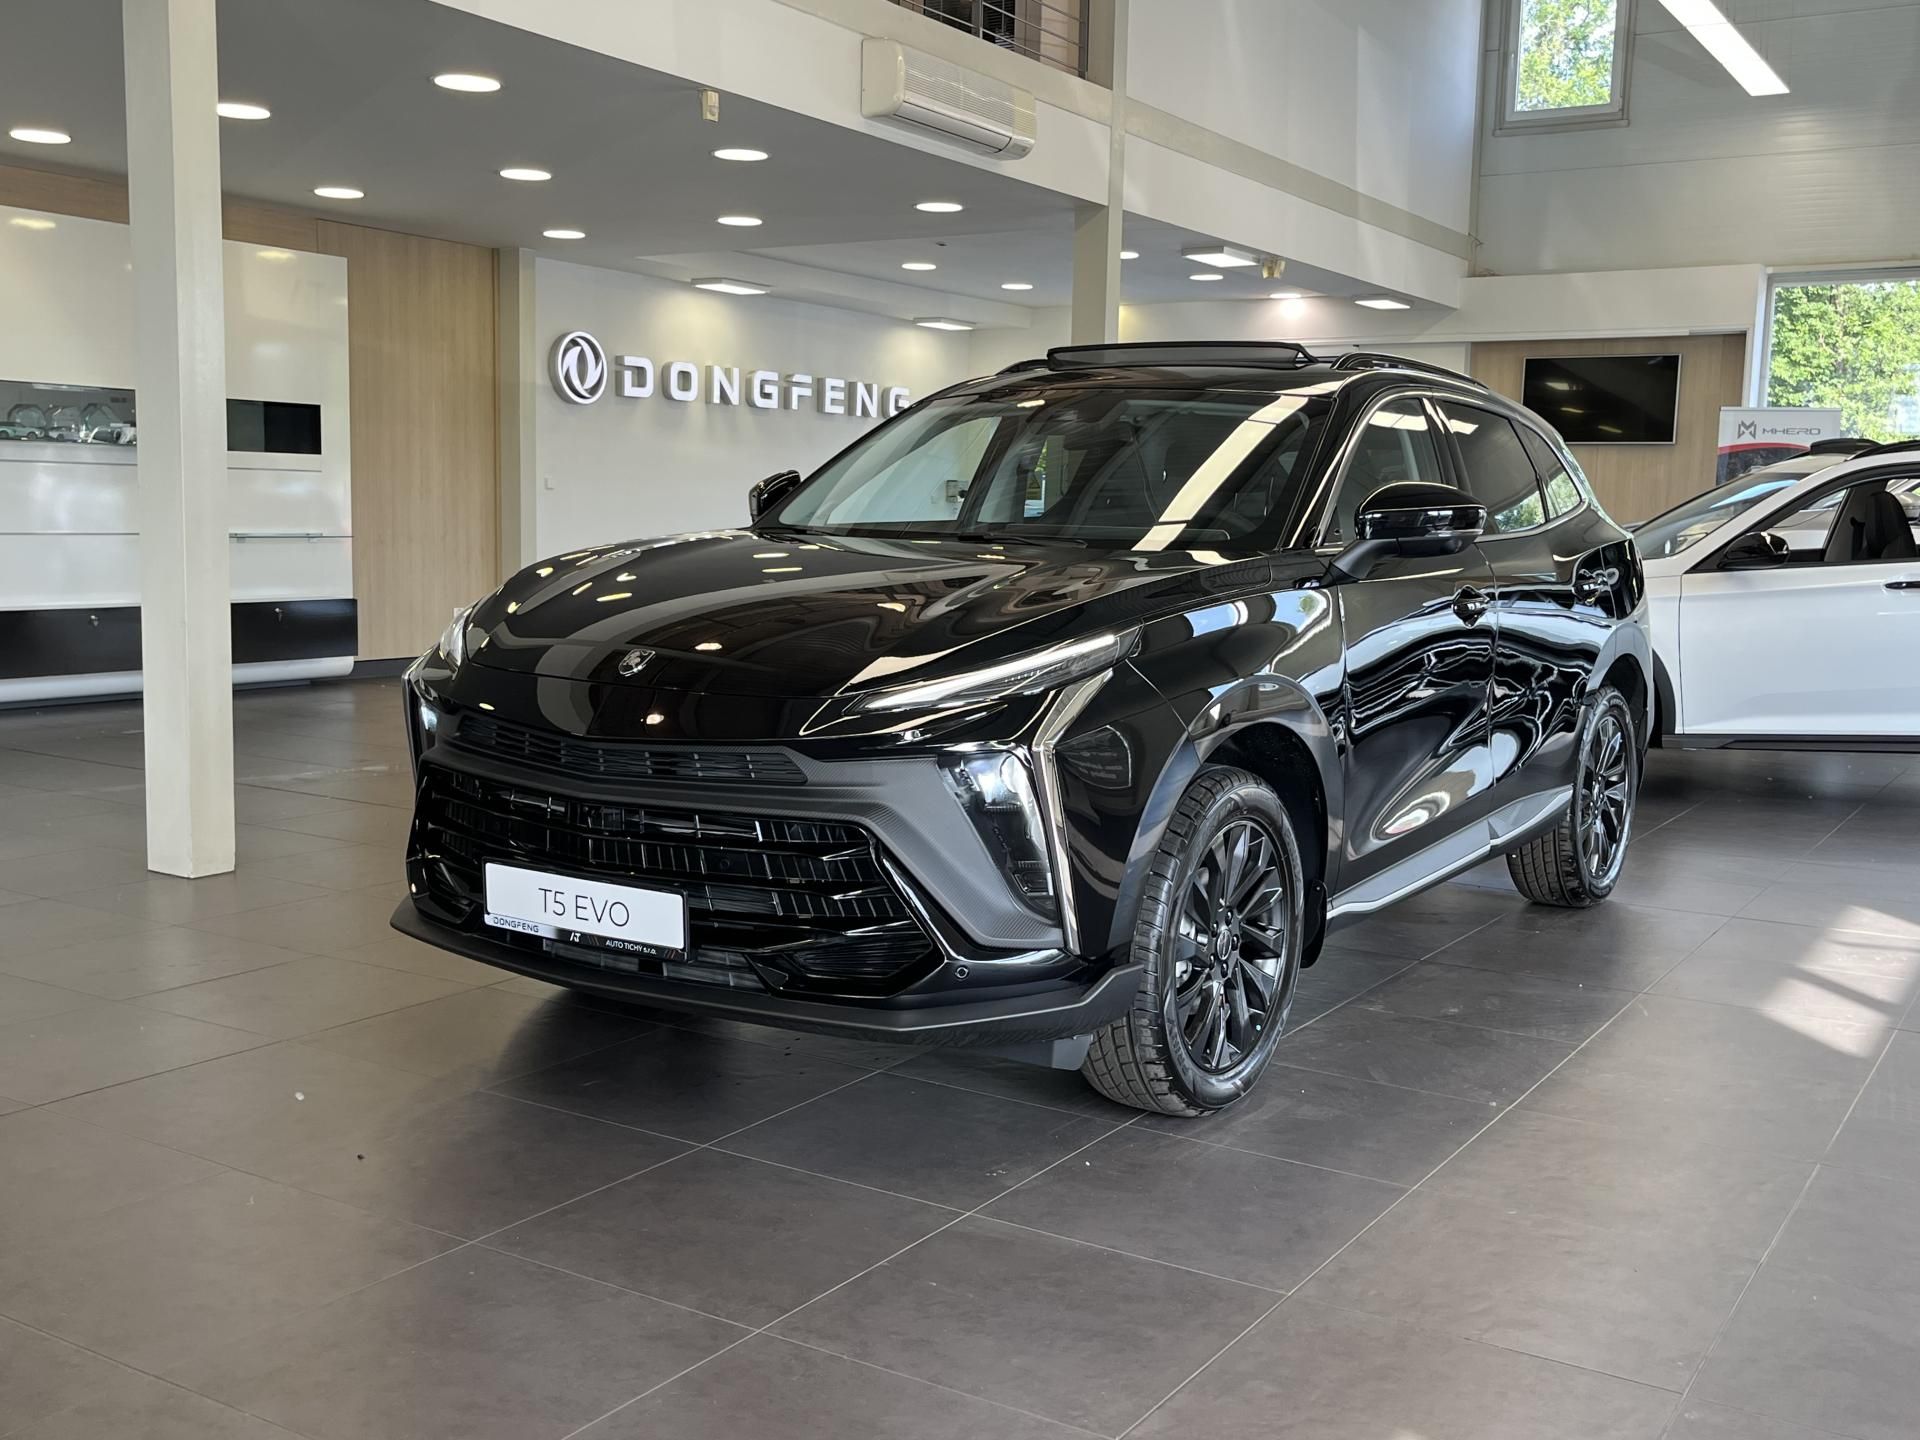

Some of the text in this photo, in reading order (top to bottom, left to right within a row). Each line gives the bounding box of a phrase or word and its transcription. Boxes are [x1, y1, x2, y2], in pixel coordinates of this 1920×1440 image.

[616, 355, 910, 418] DONGFENG
[1762, 427, 1821, 436] MHERO
[538, 887, 630, 927] T5 EVO
[493, 917, 539, 933] DONGFENG
[606, 939, 624, 949] AUTO
